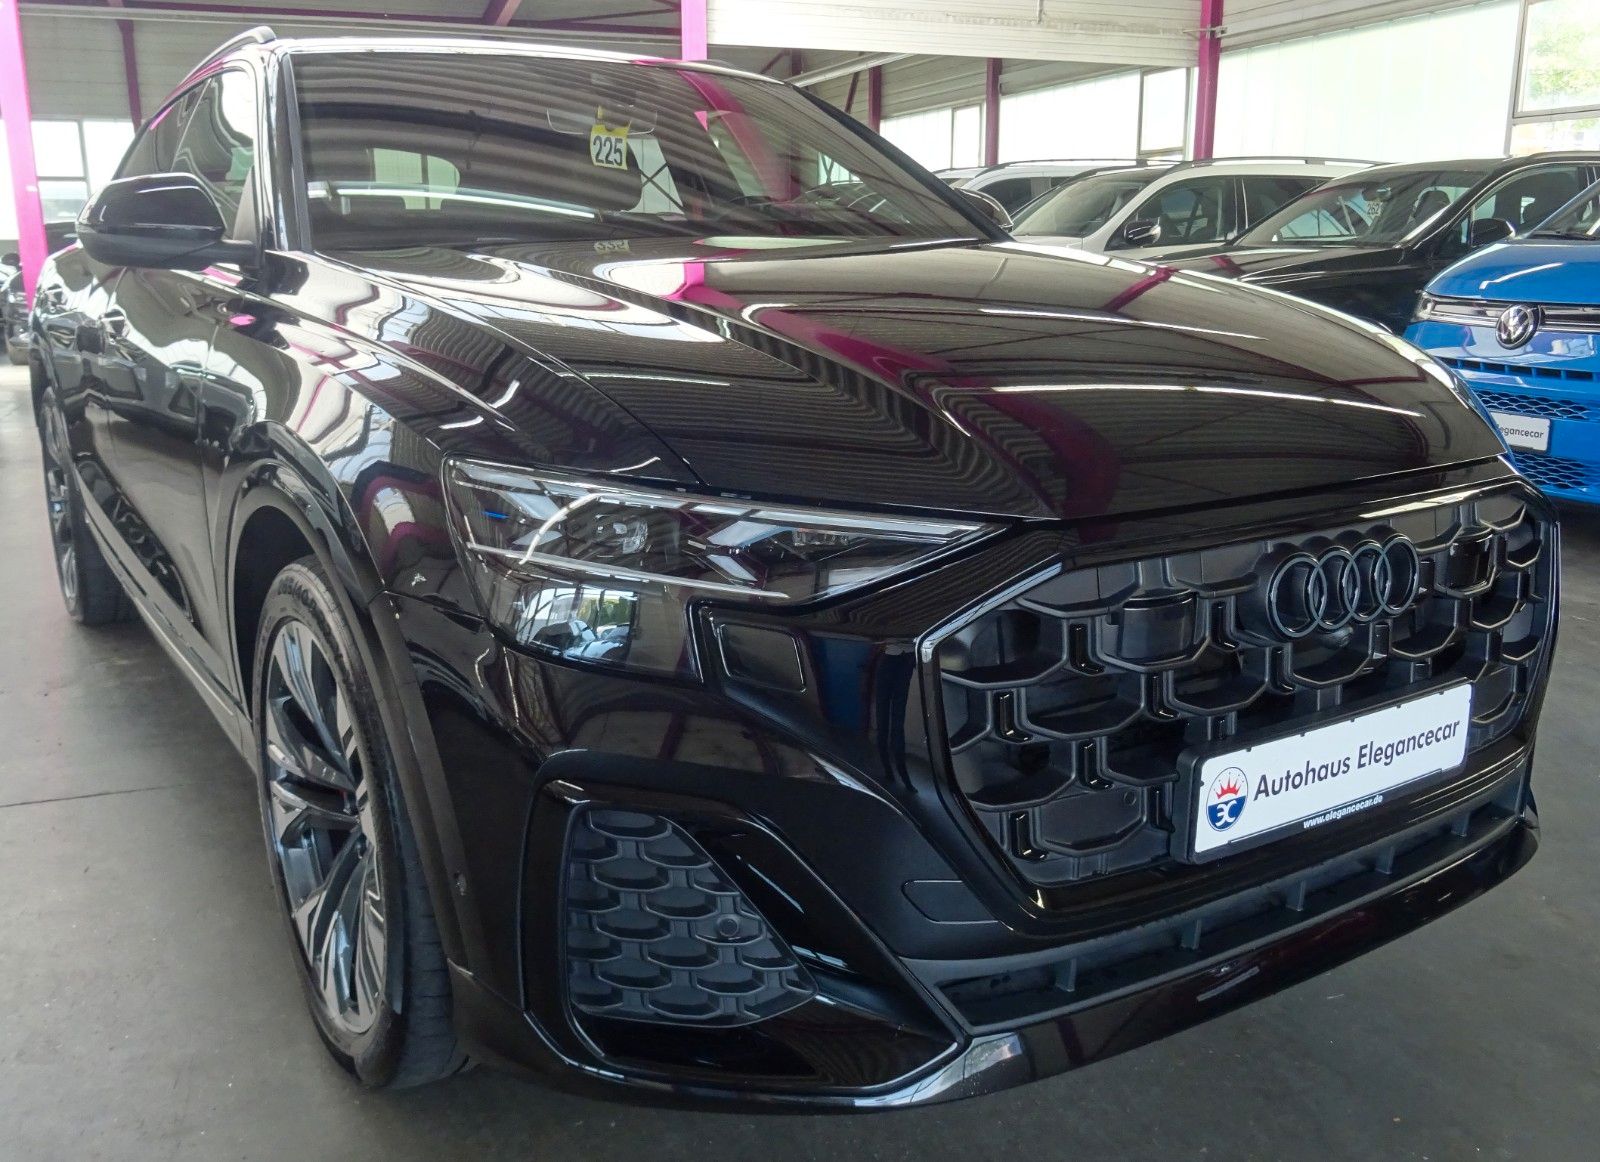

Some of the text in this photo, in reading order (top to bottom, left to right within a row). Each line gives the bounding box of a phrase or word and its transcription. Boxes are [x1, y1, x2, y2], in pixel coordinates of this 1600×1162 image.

[592, 135, 624, 167] 225
[1253, 719, 1461, 802] Autohaus Elegancecar
[1303, 794, 1384, 829] www.elegancecar.de
